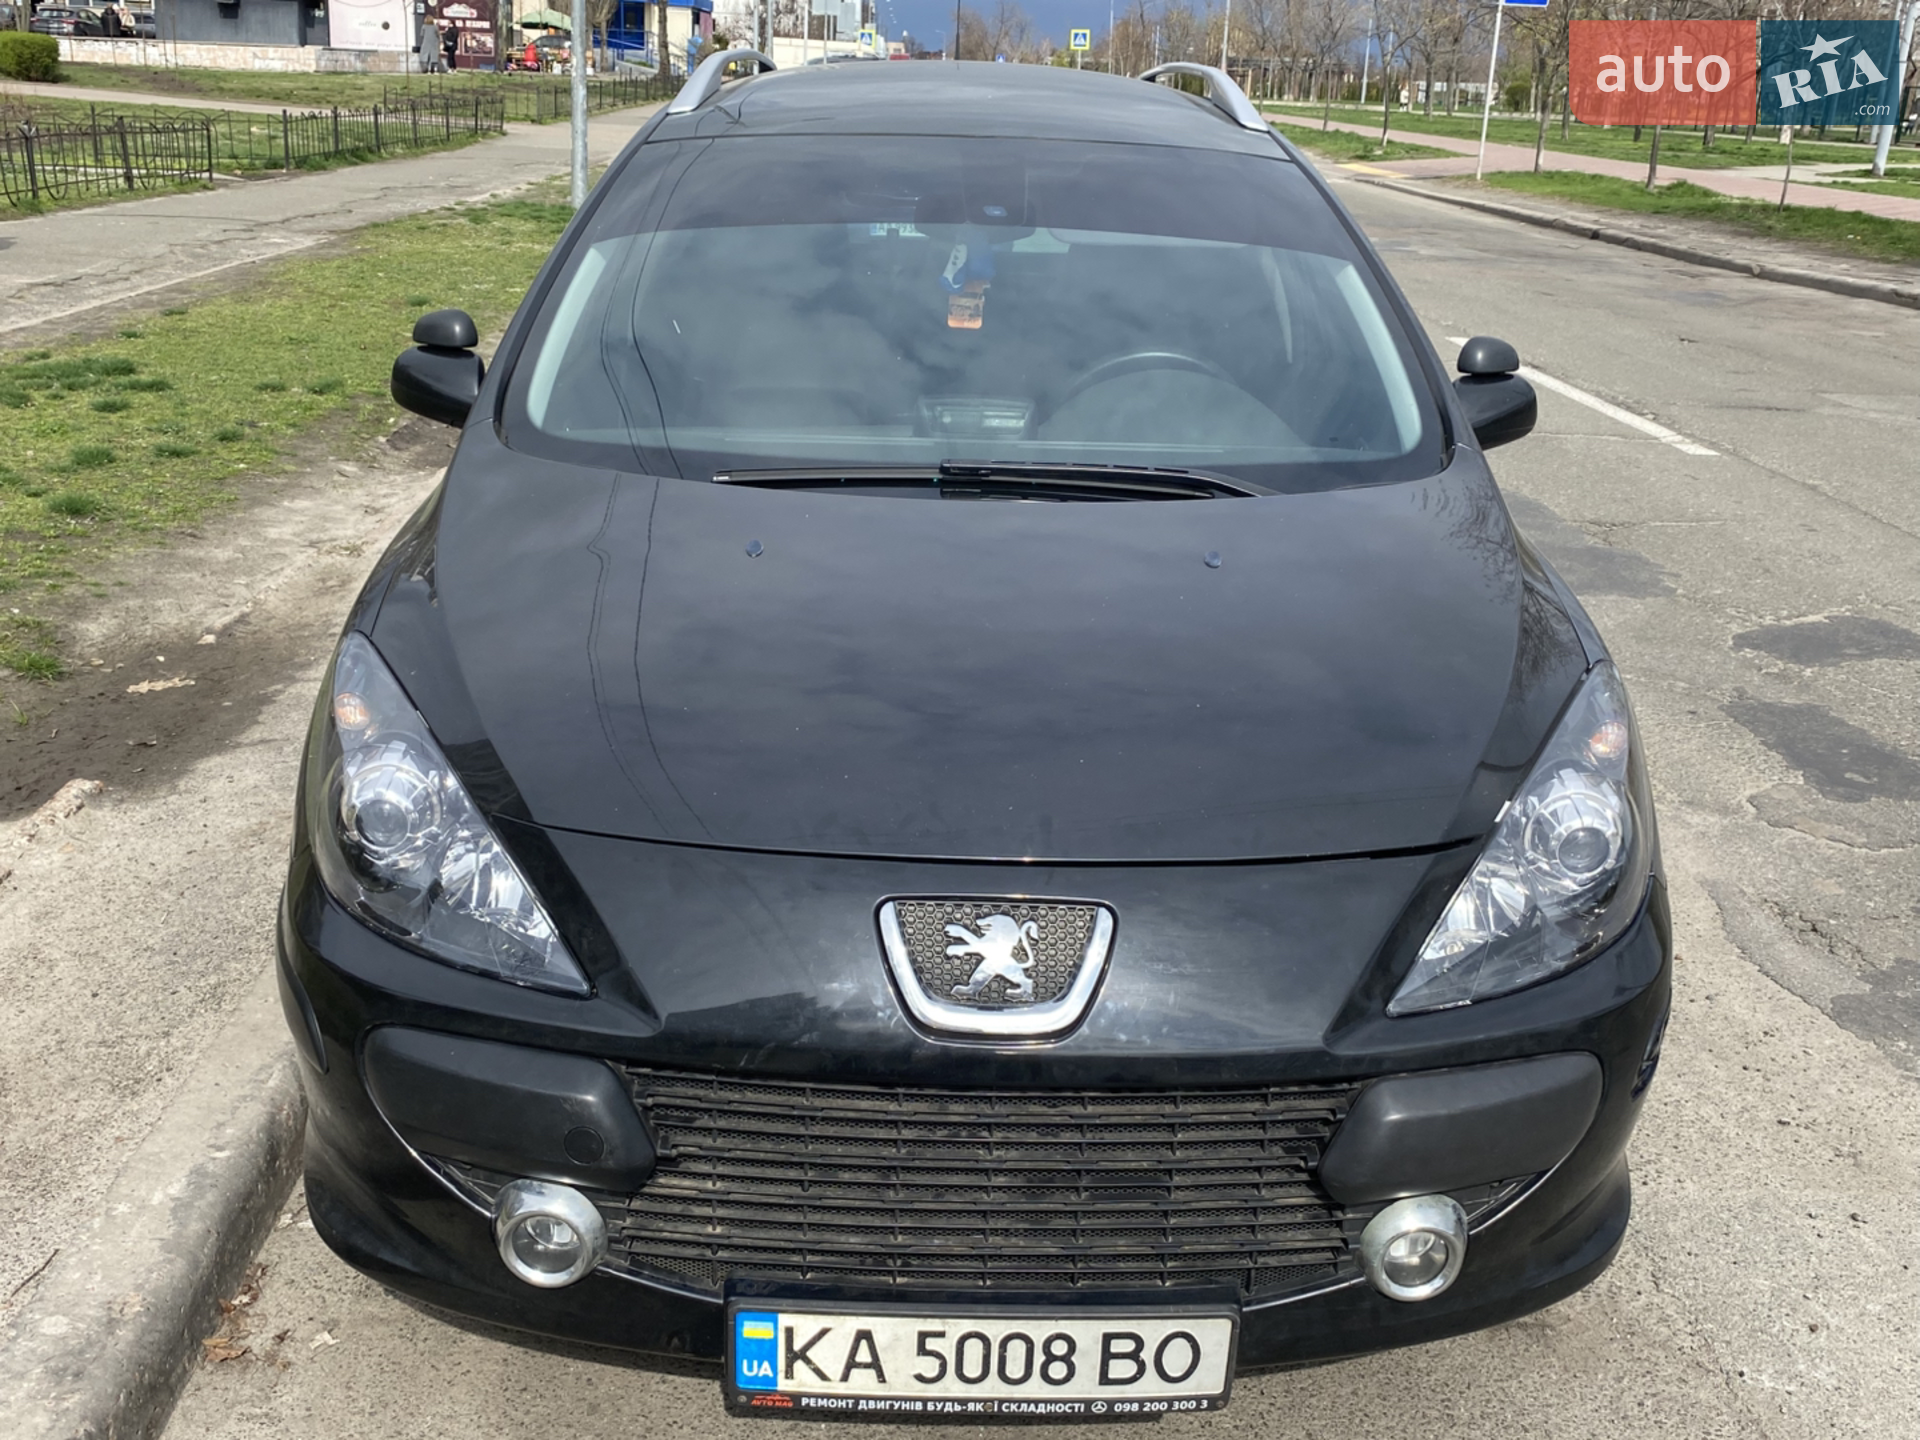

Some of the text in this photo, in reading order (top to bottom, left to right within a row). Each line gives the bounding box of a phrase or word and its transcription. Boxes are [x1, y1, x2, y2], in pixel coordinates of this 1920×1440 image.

[784, 1326, 1202, 1386] KA 5008 BO
[742, 1358, 774, 1378] UA
[801, 1396, 1208, 1413] РЕМОНТ ДВИГУНІВ БУДЬ-ЯКЇ СКЛАДНОСТІ 098 200 300 3
